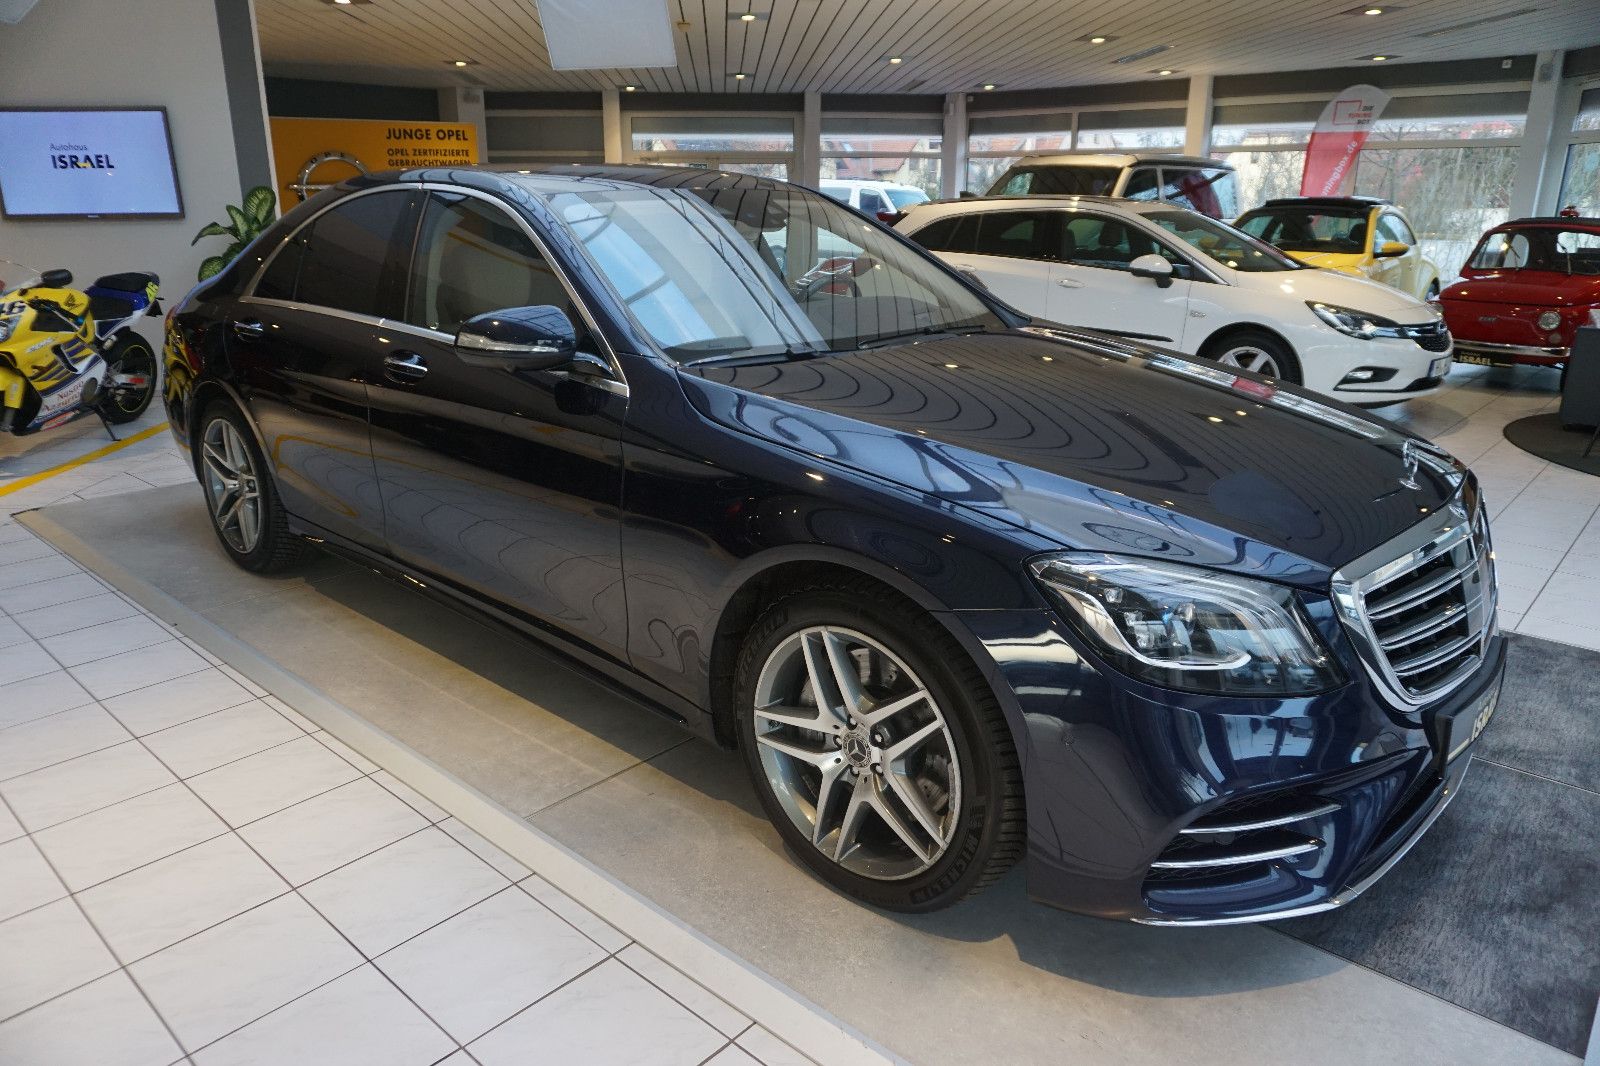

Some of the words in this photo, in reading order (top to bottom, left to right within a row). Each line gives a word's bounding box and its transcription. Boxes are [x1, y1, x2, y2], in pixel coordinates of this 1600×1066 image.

[386, 127, 432, 141] JUNGE
[435, 128, 469, 141] OPEL
[49, 142, 88, 151] Autohaus
[386, 148, 409, 156] OPEL
[412, 148, 470, 157] ZERTIFIZIERTE
[51, 154, 115, 169] ISRAEL
